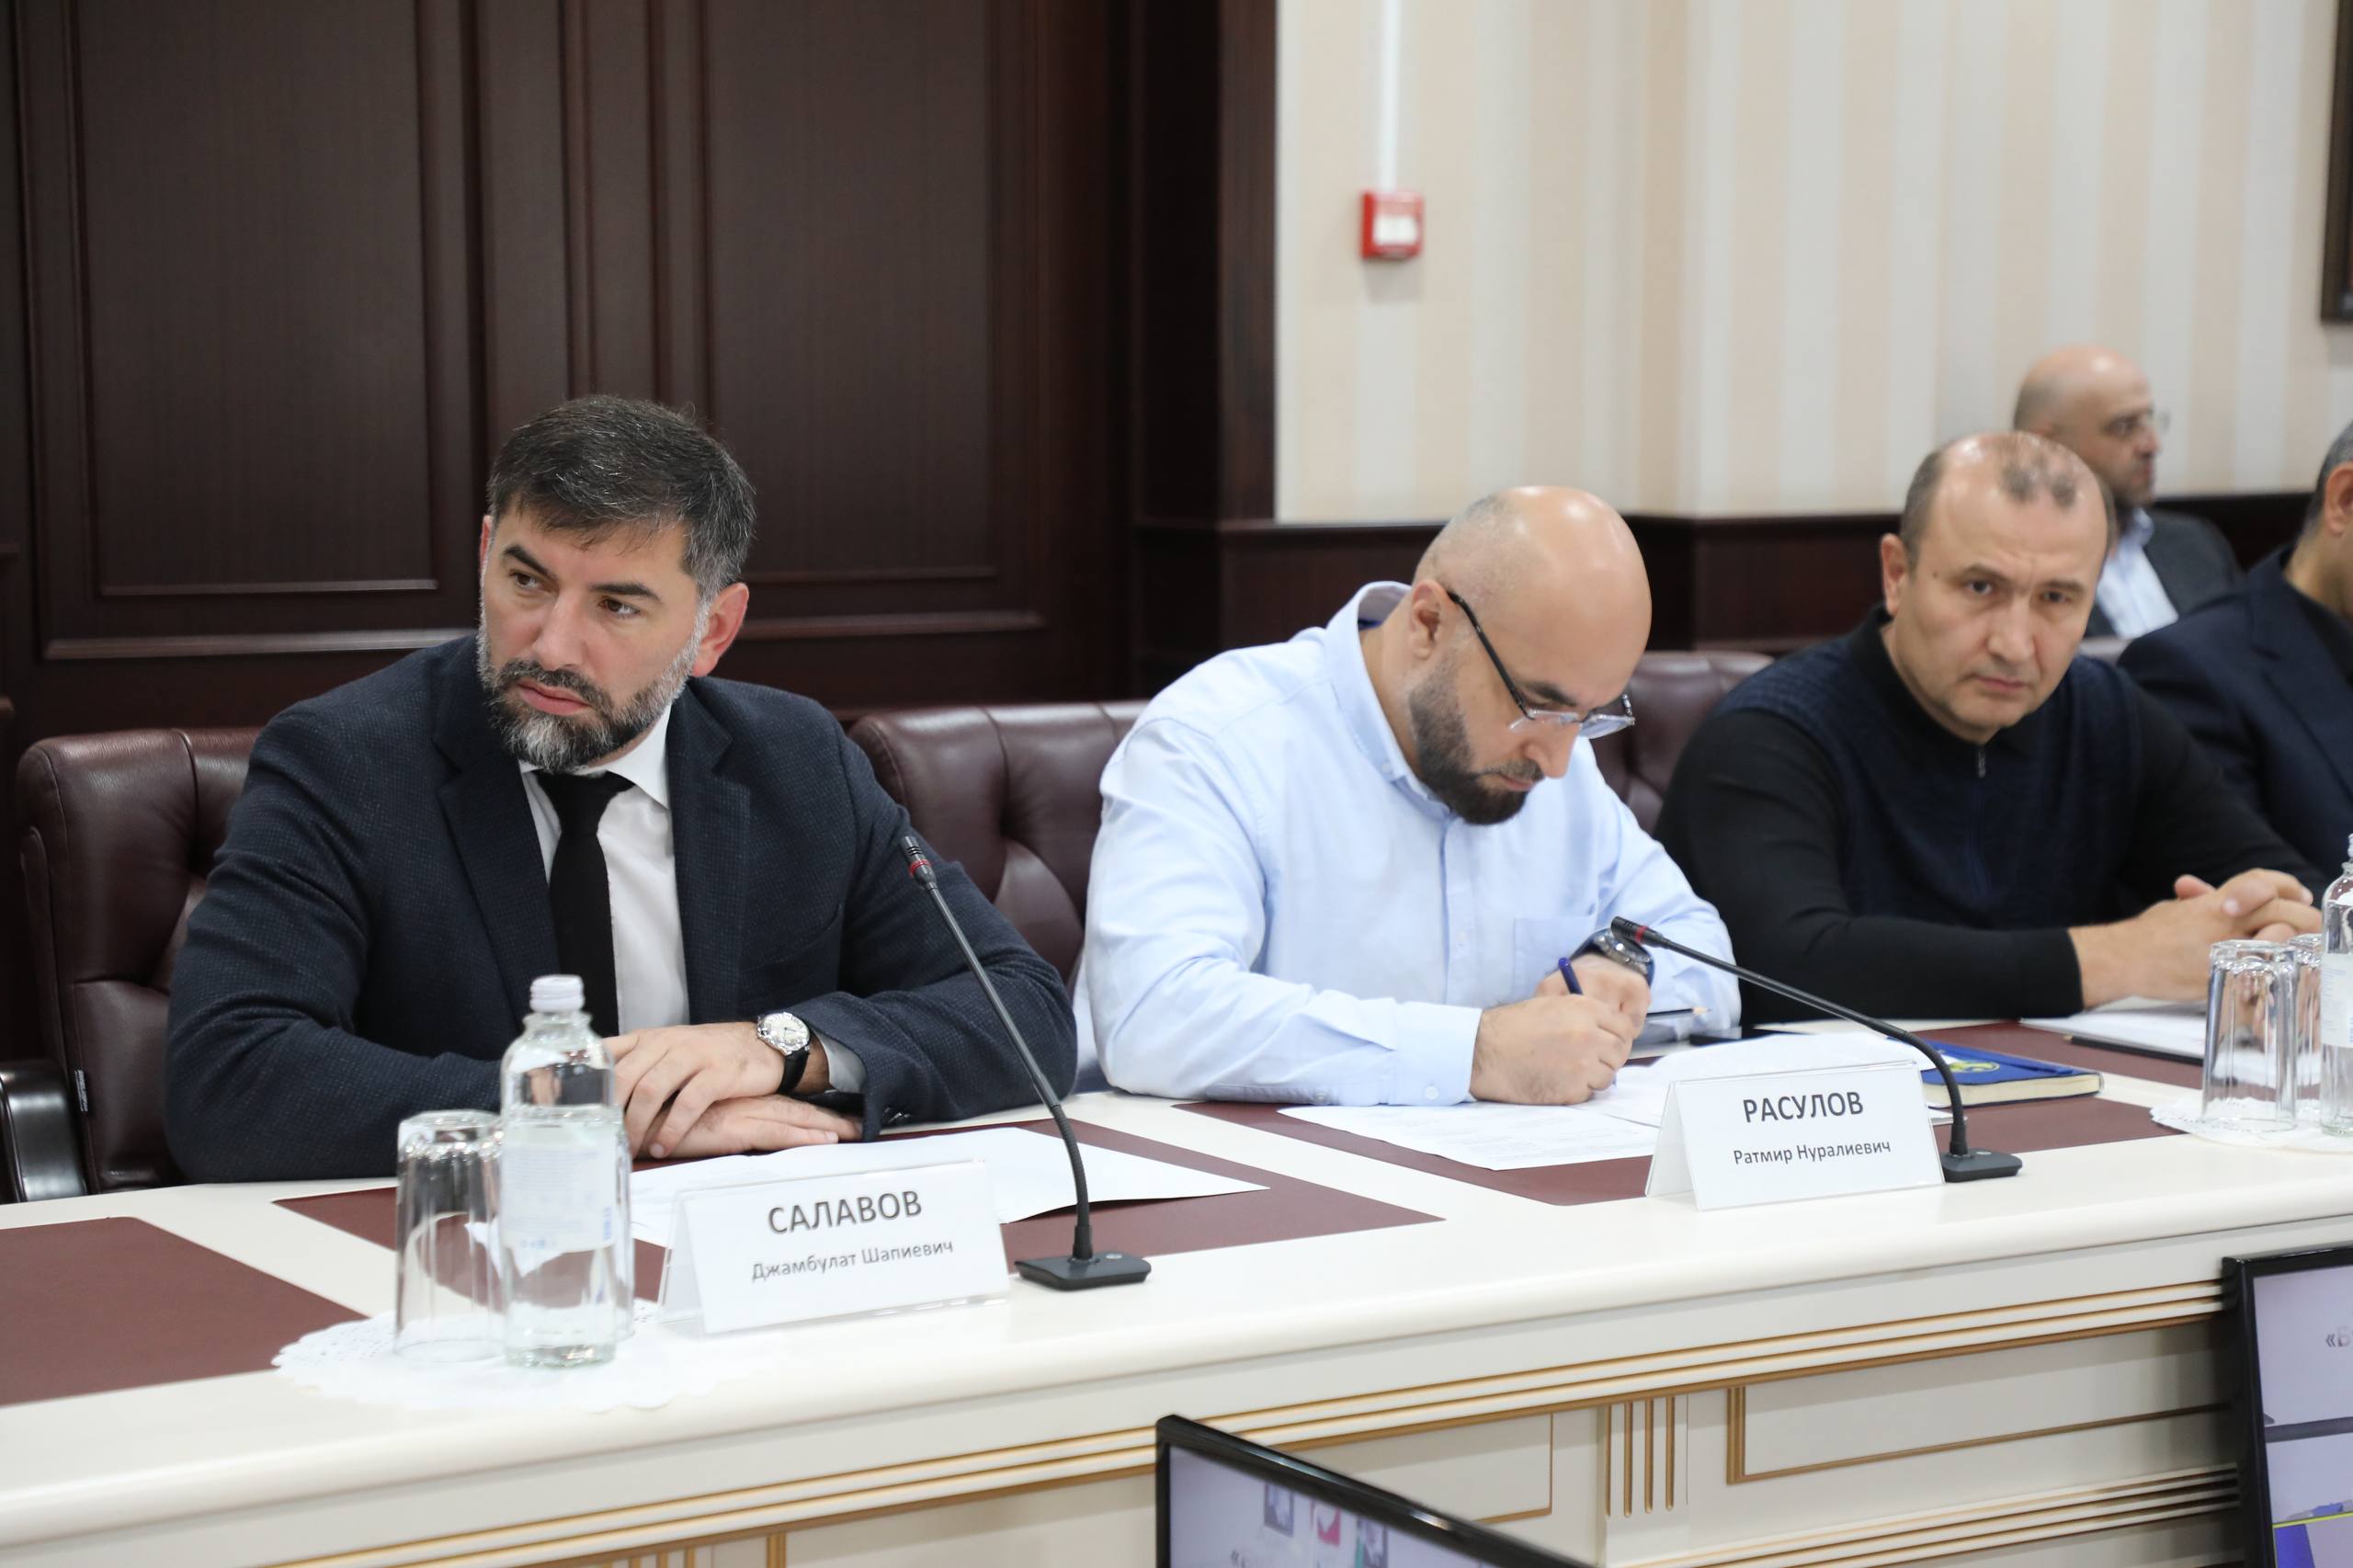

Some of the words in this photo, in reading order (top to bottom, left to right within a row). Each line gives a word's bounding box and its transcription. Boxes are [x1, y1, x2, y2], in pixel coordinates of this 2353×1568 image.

[1743, 1091, 1864, 1123] РАСУЛОВ
[1733, 1149, 1793, 1165] Ратмир
[1797, 1141, 1892, 1163] Нуралиевич
[767, 1189, 923, 1234] САЛАВОВ
[752, 1254, 857, 1282] Джамбулат
[861, 1241, 953, 1265] Шапиевич
